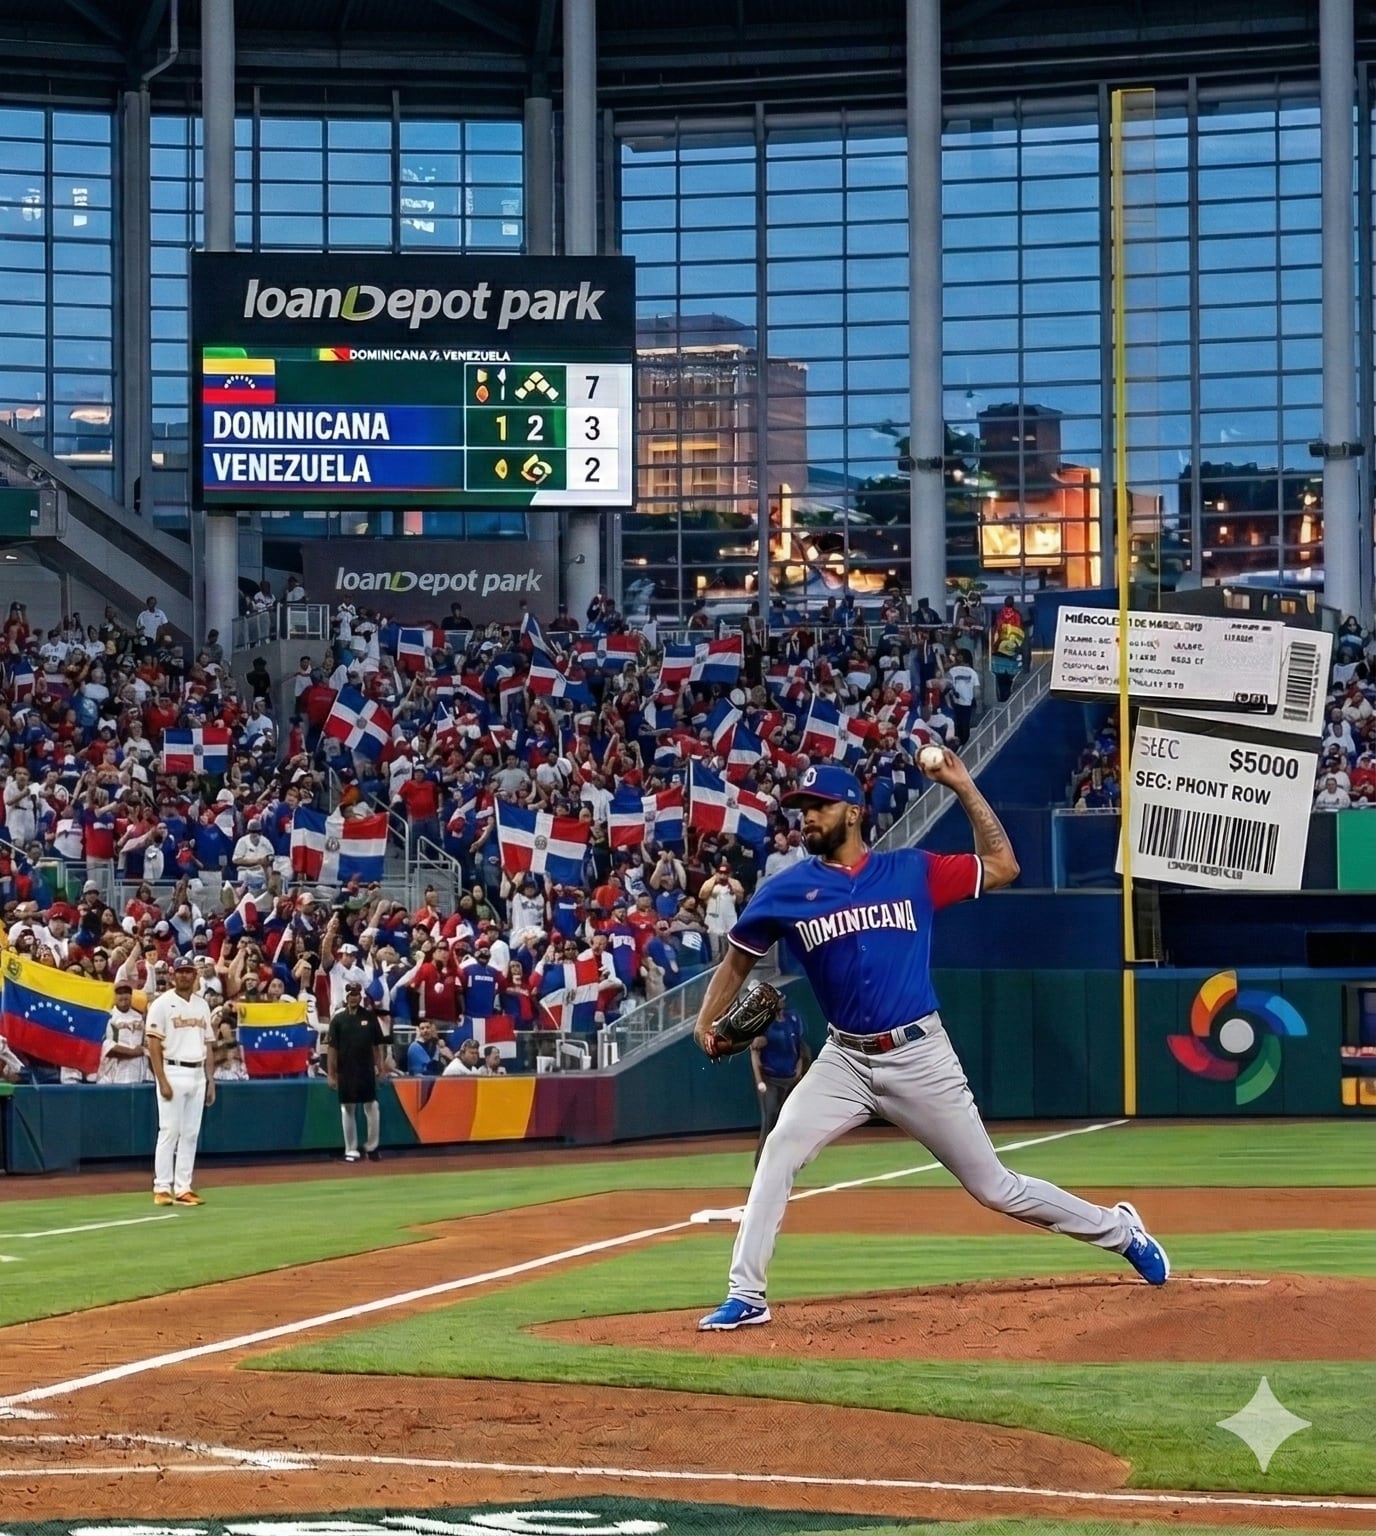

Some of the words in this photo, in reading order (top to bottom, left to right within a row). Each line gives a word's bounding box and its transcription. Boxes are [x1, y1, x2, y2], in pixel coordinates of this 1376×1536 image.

[243, 279, 491, 329] loanDepot
[497, 281, 606, 330] park
[349, 349, 426, 361] DOMINICANA
[443, 350, 511, 362] VENEZUELA
[585, 375, 600, 400] 7
[213, 411, 391, 440] DOMINICANA
[496, 415, 507, 441] 1
[526, 415, 544, 441] 2
[584, 415, 601, 441] 3
[212, 453, 372, 482] VENEZUELA
[584, 456, 601, 483] 2
[335, 566, 478, 596] loanDepot
[481, 568, 543, 597] park
[1065, 613, 1120, 627] MIÉRCOLE
[1229, 749, 1299, 780] $5000
[1135, 770, 1172, 791] SEC:
[1175, 776, 1229, 799] PHONT
[1231, 785, 1272, 806] ROW
[795, 899, 918, 953] DOMINICANA
